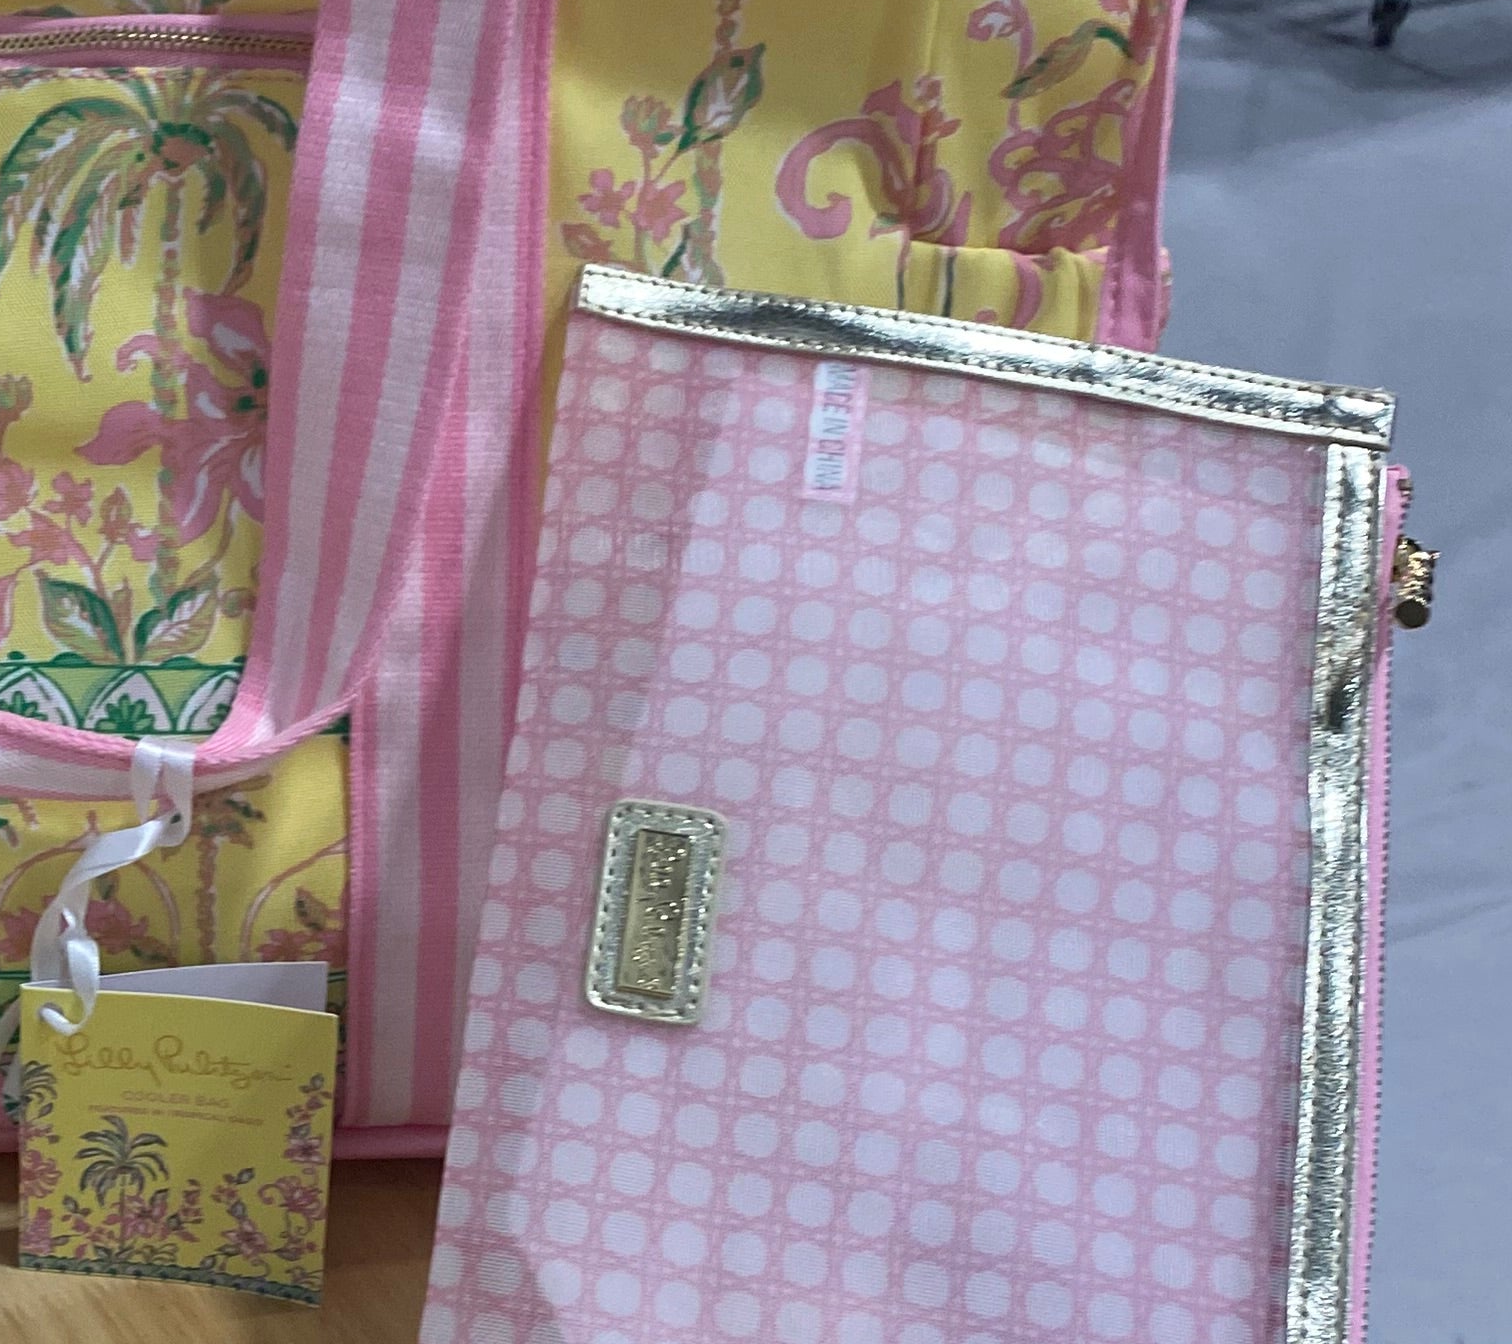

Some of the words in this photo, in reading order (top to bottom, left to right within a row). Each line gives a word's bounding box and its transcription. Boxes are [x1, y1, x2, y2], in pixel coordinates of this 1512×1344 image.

[822, 363, 858, 414] MADE
[822, 417, 850, 436] IN
[56, 1032, 162, 1087] Lilly
[154, 1034, 292, 1090] Pulitzer
[120, 1089, 191, 1105] COOLER
[194, 1094, 231, 1109] BAG
